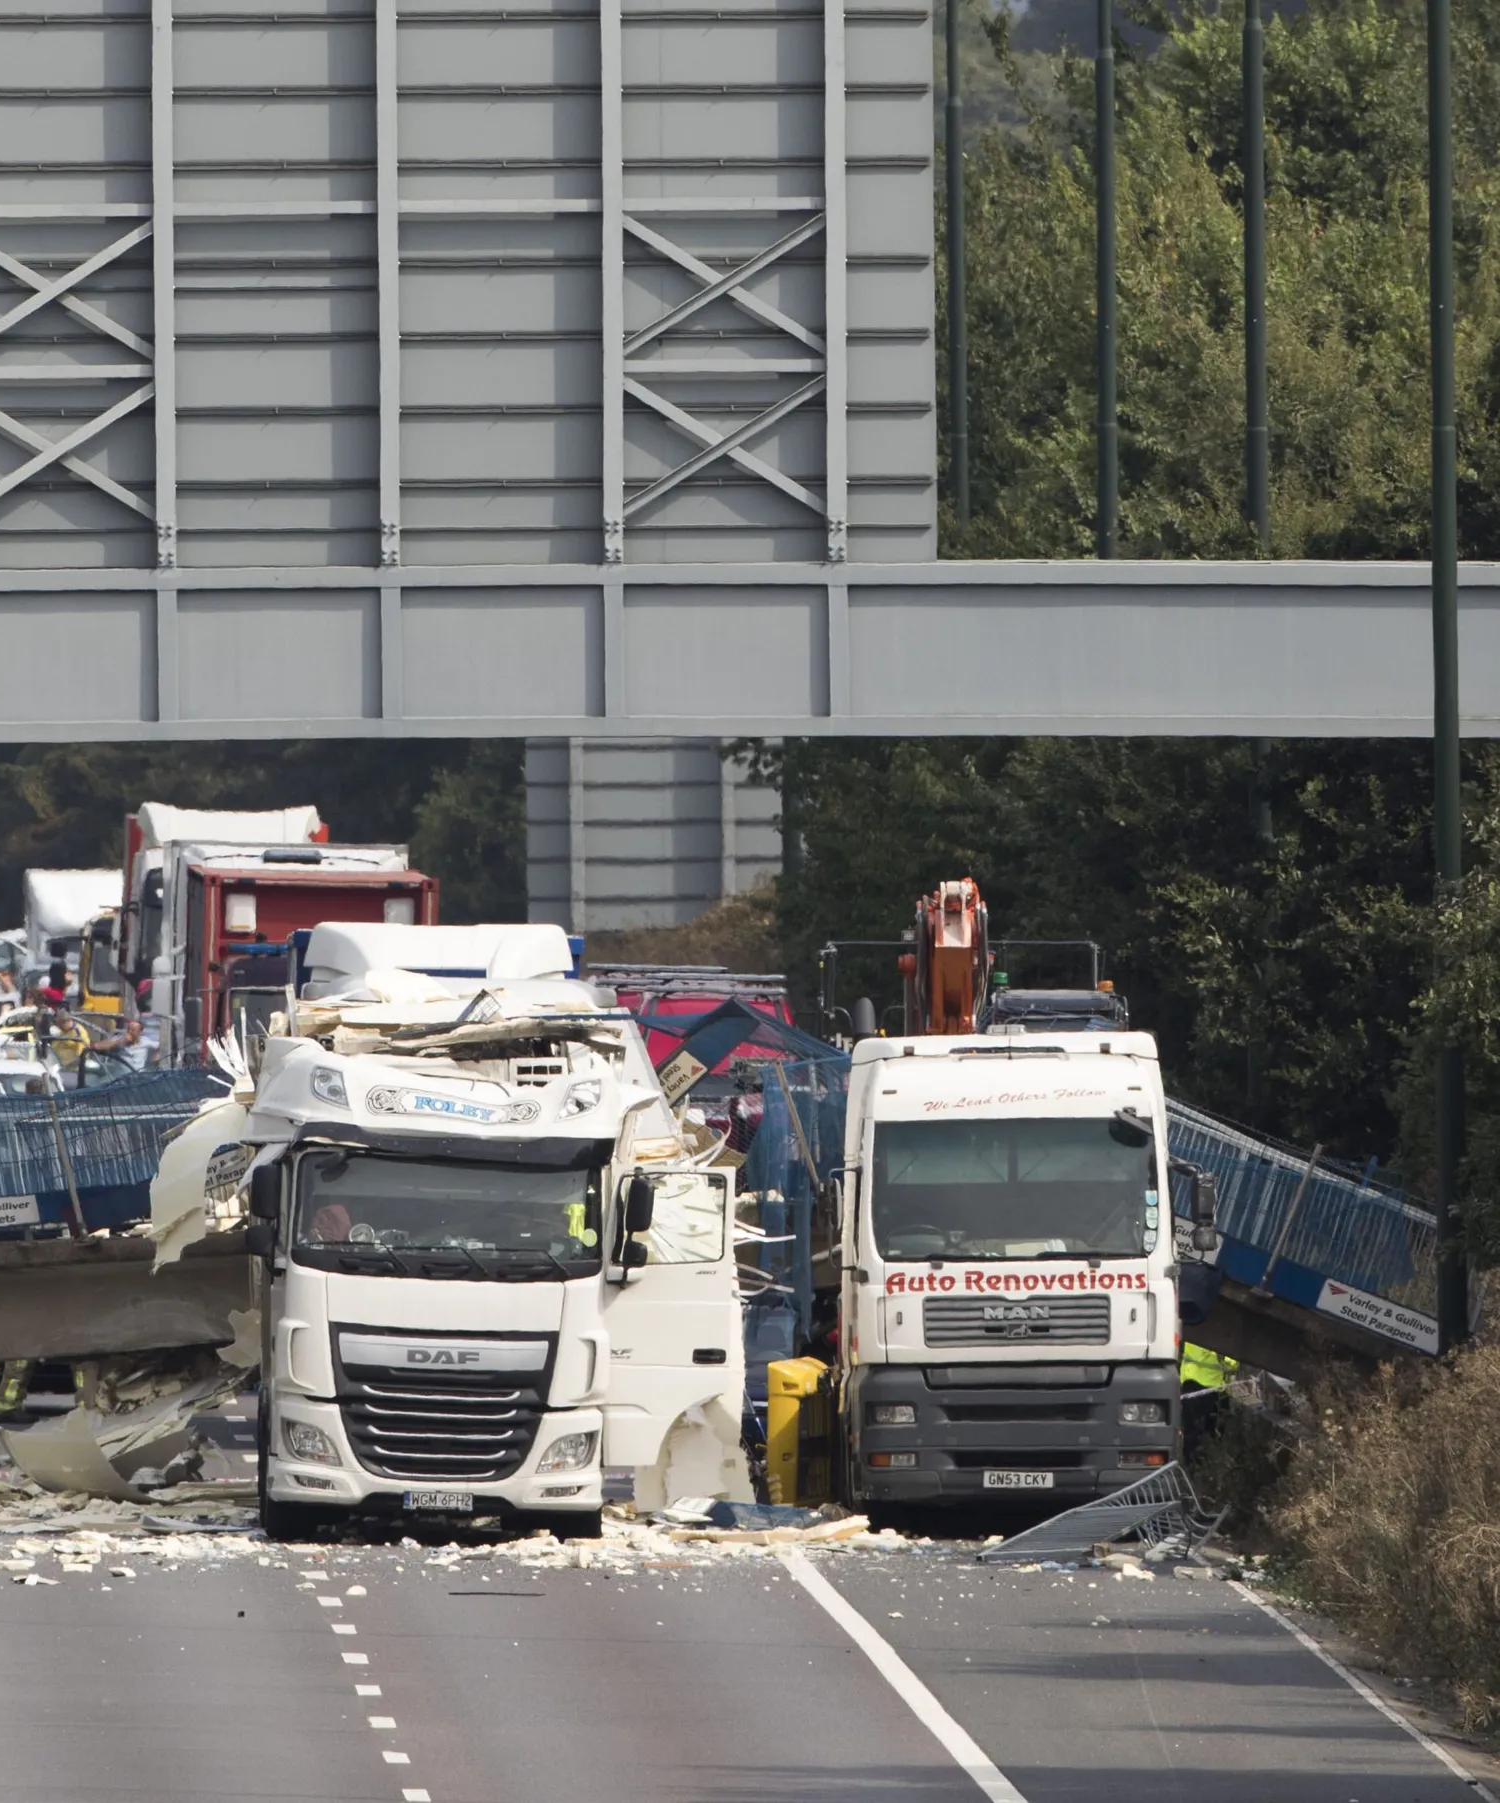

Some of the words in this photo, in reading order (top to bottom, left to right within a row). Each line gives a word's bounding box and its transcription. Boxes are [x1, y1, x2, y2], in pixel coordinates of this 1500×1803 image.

[414, 1096, 496, 1121] FOLEY
[923, 1101, 949, 1112] We
[952, 1096, 993, 1108] Lead
[998, 1092, 1047, 1103] Others
[1053, 1088, 1106, 1099] Follow
[885, 1272, 956, 1294] Auto
[964, 1270, 1147, 1293] Renovations
[983, 1306, 1050, 1320] MAN
[1340, 1305, 1368, 1322] Steel
[1368, 1317, 1417, 1342] Parapets
[1349, 1294, 1383, 1316] Varley
[1384, 1308, 1393, 1318] &
[1395, 1312, 1437, 1335] Gulliver
[407, 1349, 479, 1364] DAF
[988, 1473, 1021, 1485] GN53
[1024, 1474, 1047, 1485] CKY
[412, 1493, 437, 1506] WGM
[441, 1494, 471, 1507] 6PH2
